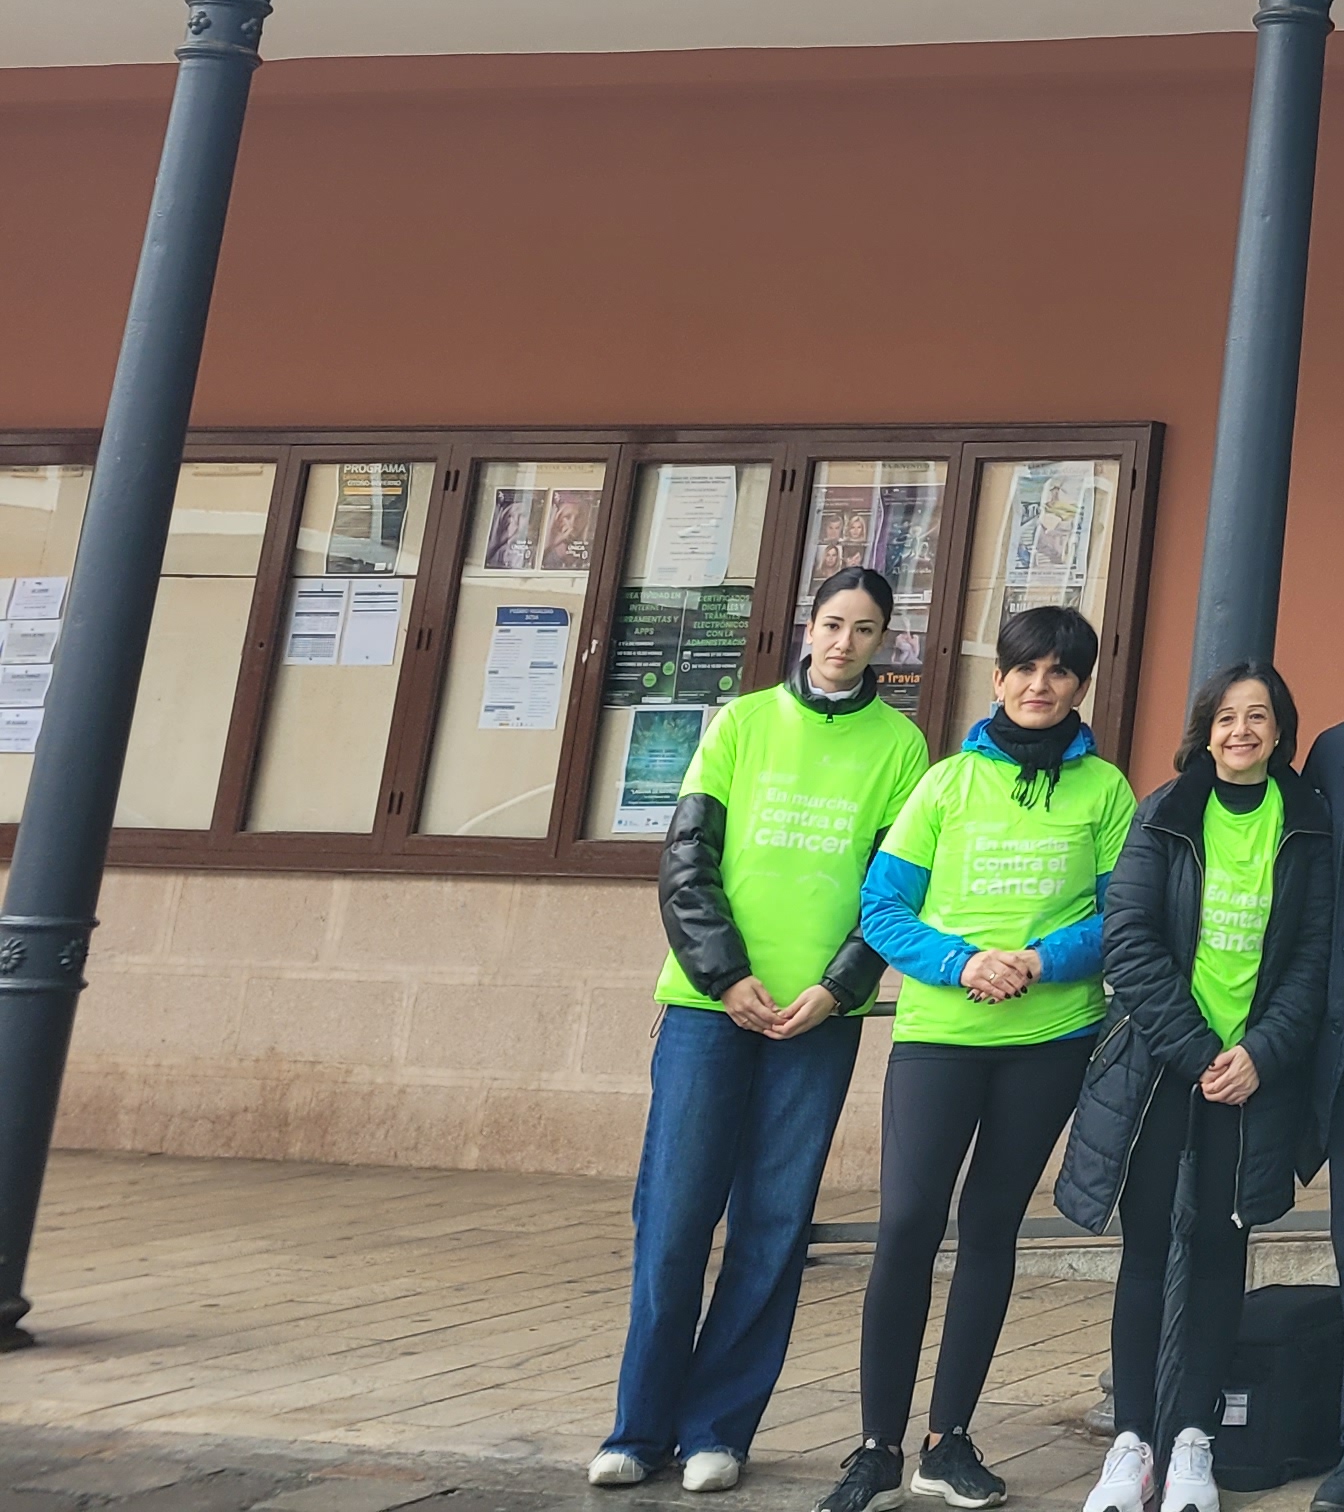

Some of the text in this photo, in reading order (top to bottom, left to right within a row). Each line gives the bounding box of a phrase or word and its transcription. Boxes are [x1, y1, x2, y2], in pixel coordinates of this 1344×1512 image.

[343, 463, 407, 474] PROGRAMA
[693, 620, 749, 628] ELECTRÓNICOS
[684, 638, 747, 646] ADMINISTRACIÓ
[887, 672, 922, 683] Travia
[766, 787, 859, 813] En marcha
[760, 806, 854, 832] contra el
[754, 824, 850, 856] cáncer
[975, 836, 997, 851] En
[973, 855, 1067, 872] contra el
[971, 872, 1066, 895] cáncer
[1206, 884, 1227, 901] En
